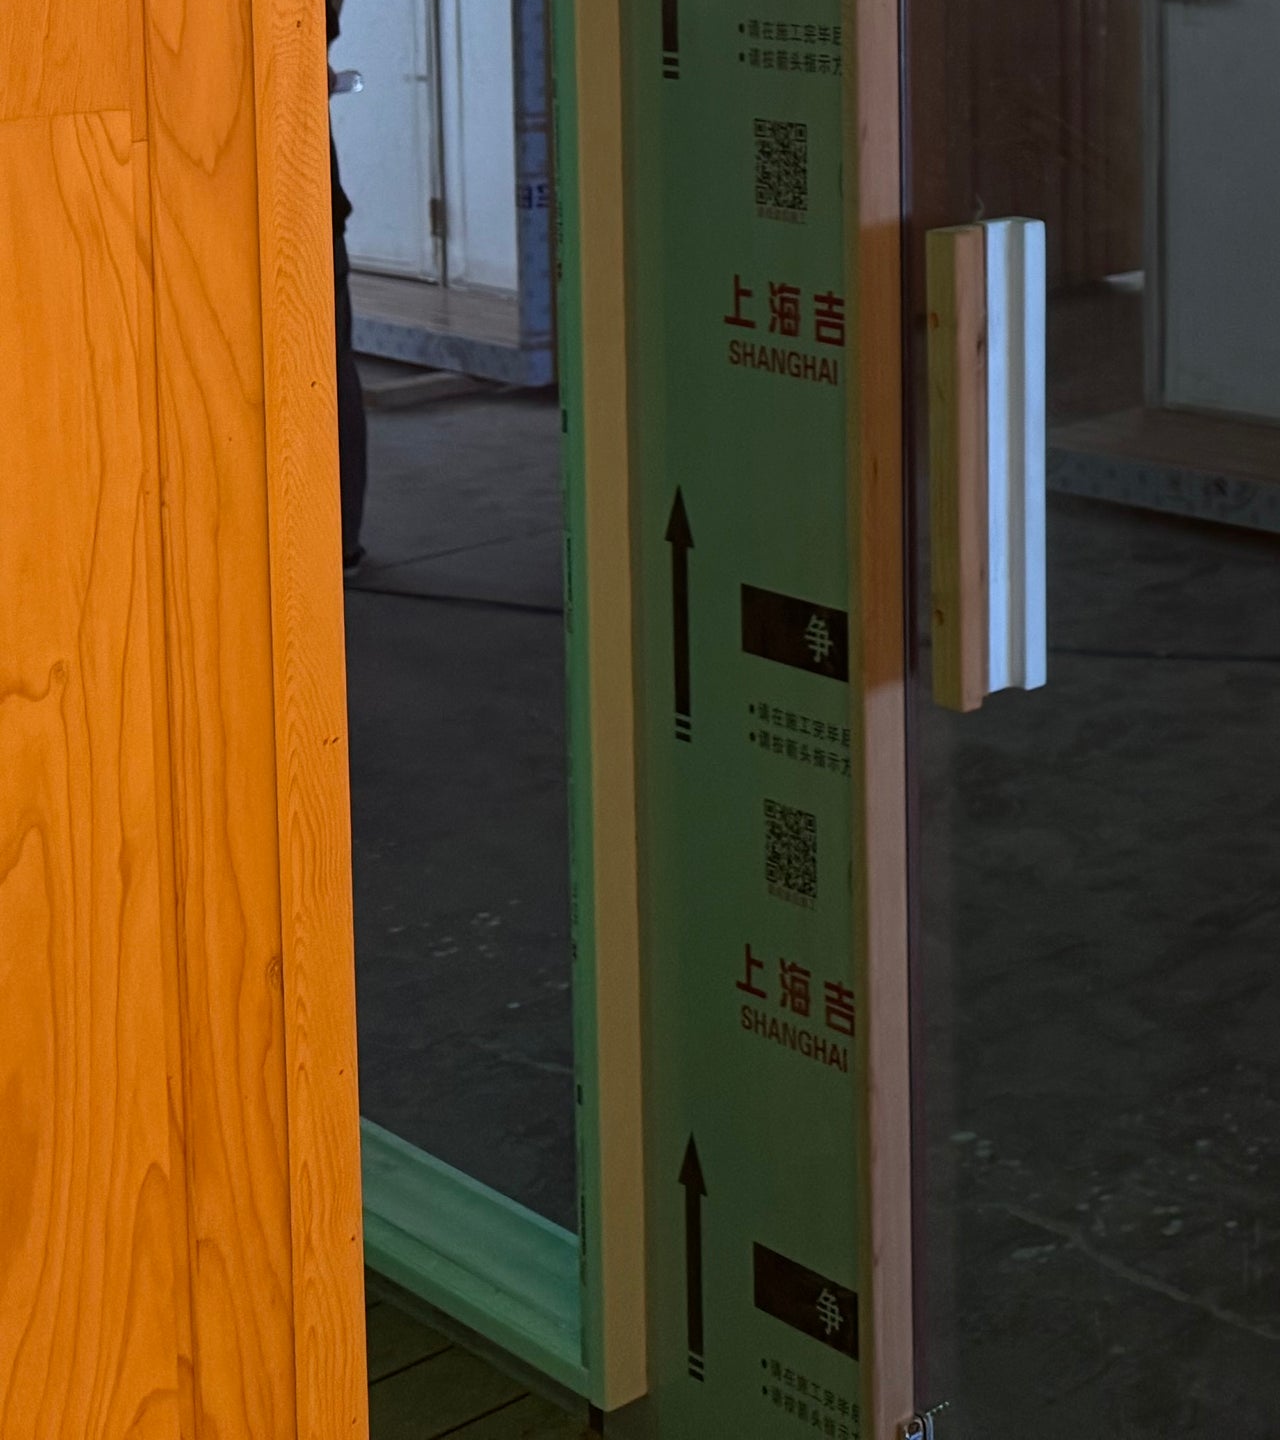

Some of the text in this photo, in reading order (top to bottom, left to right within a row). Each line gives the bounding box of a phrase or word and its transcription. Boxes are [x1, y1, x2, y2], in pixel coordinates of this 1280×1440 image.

[724, 274, 845, 348] 上海吉
[729, 339, 839, 386] SHANGHAI
[803, 613, 834, 664] 争
[736, 943, 855, 1038] 上海吉
[741, 1004, 849, 1074] SHANGHAI
[815, 1287, 843, 1335] 争
